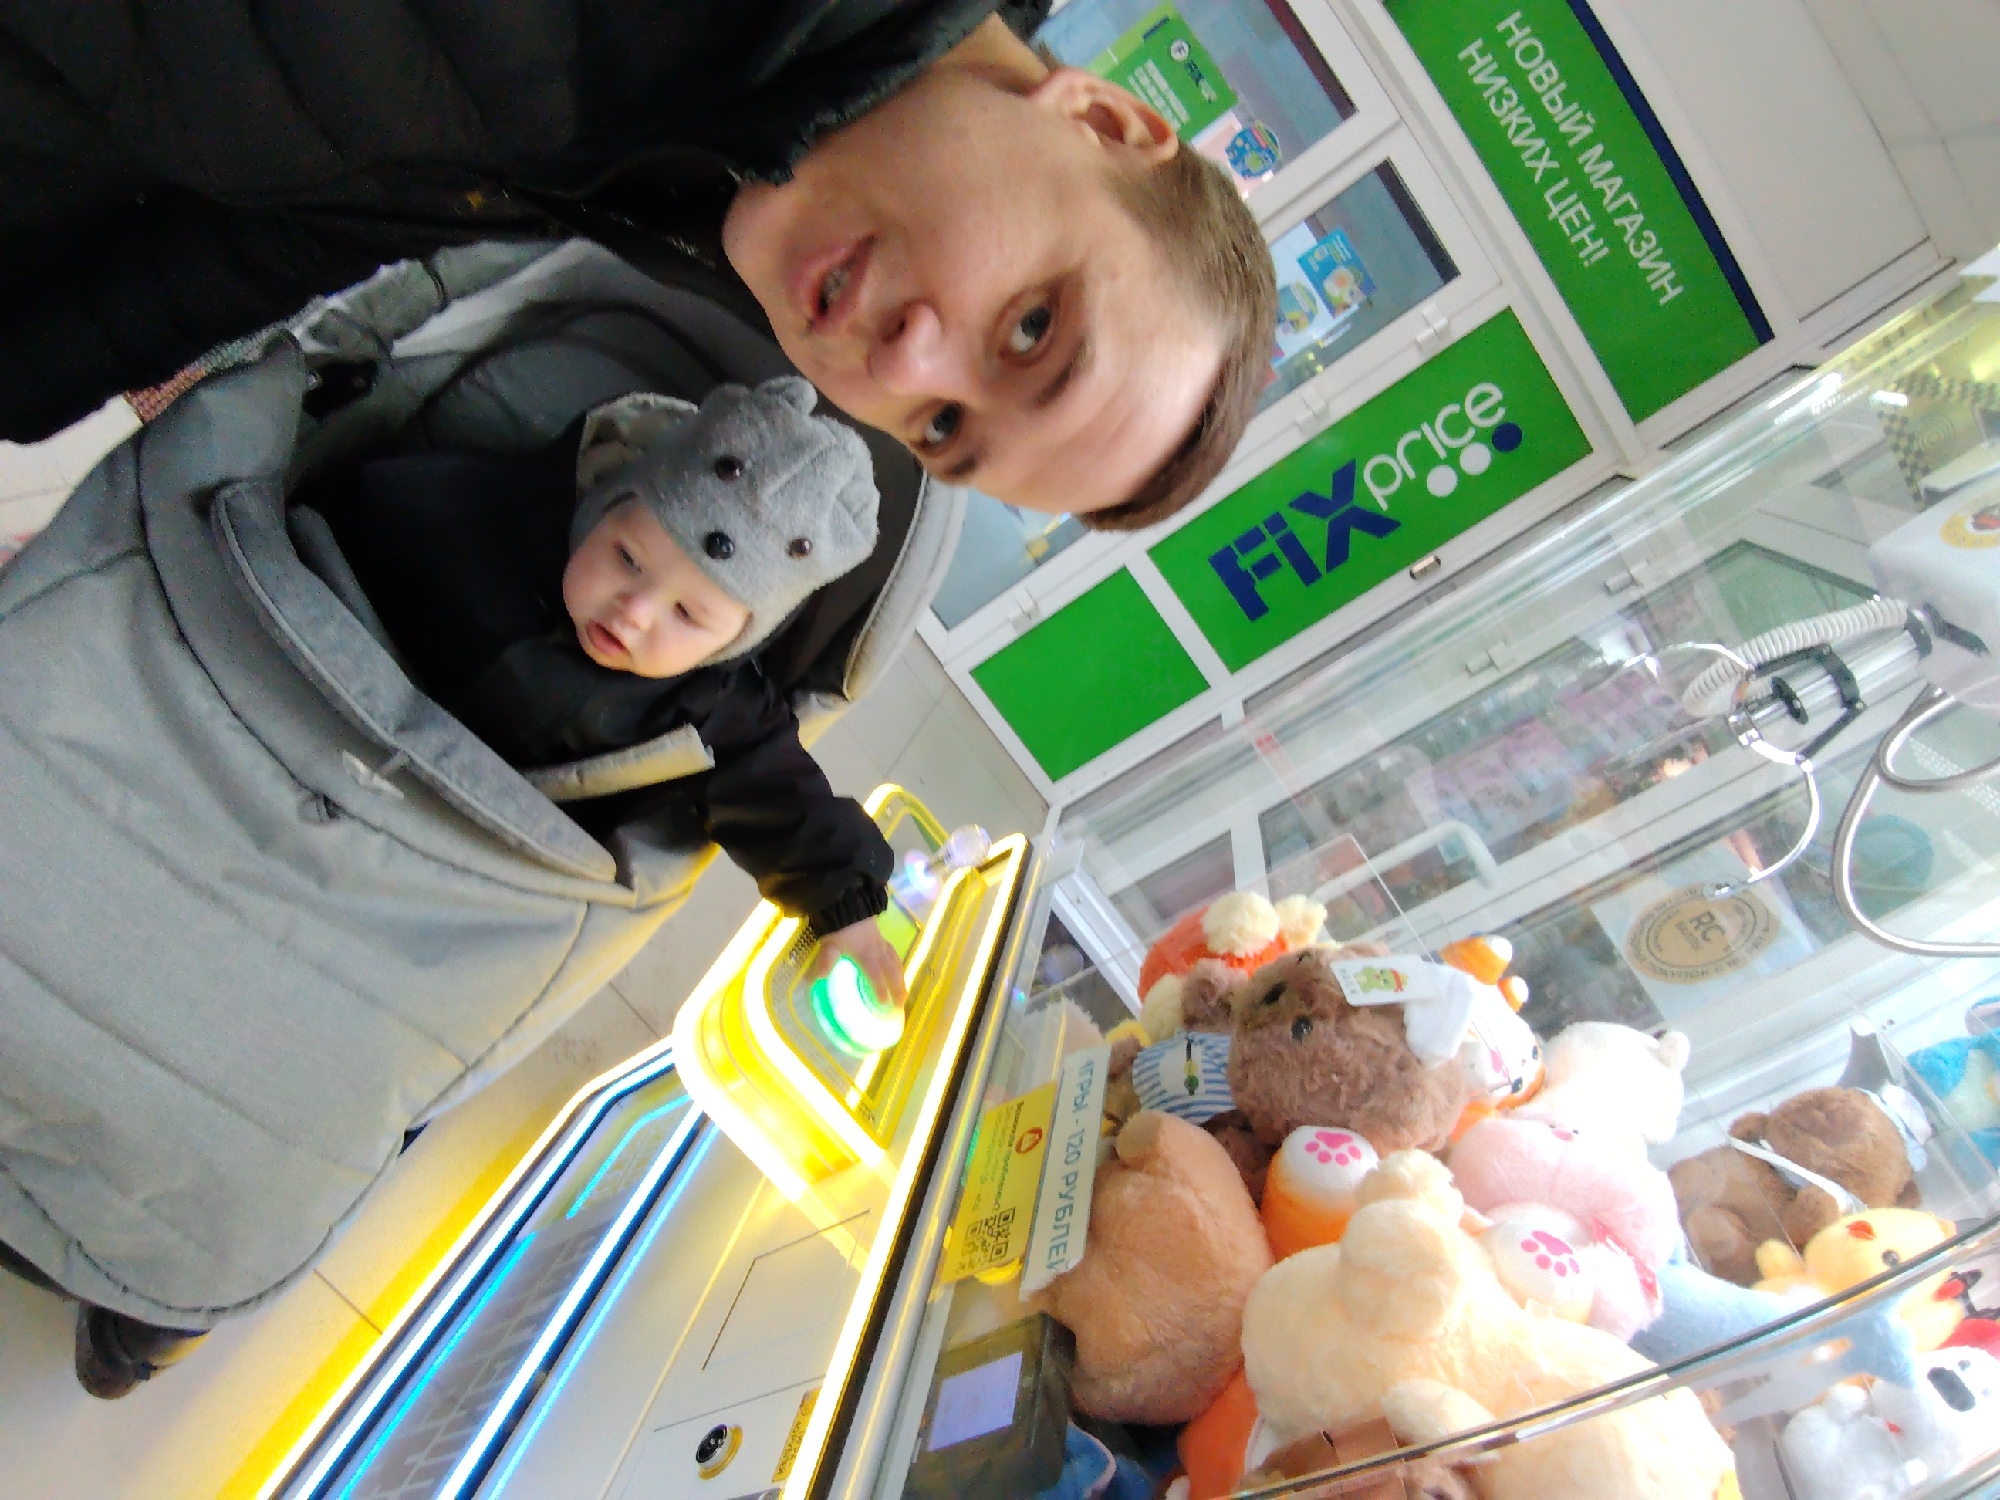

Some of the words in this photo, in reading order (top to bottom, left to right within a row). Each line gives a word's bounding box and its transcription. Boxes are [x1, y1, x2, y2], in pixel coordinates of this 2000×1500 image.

[1458, 38, 1559, 184] НИЗКИХ
[1543, 177, 1609, 268] ЦЕН!
[1496, 10, 1595, 148] НОВЫЙ
[1578, 143, 1684, 306] МАГАЗИН
[1363, 382, 1506, 511] price
[1065, 1127, 1085, 1165] 120
